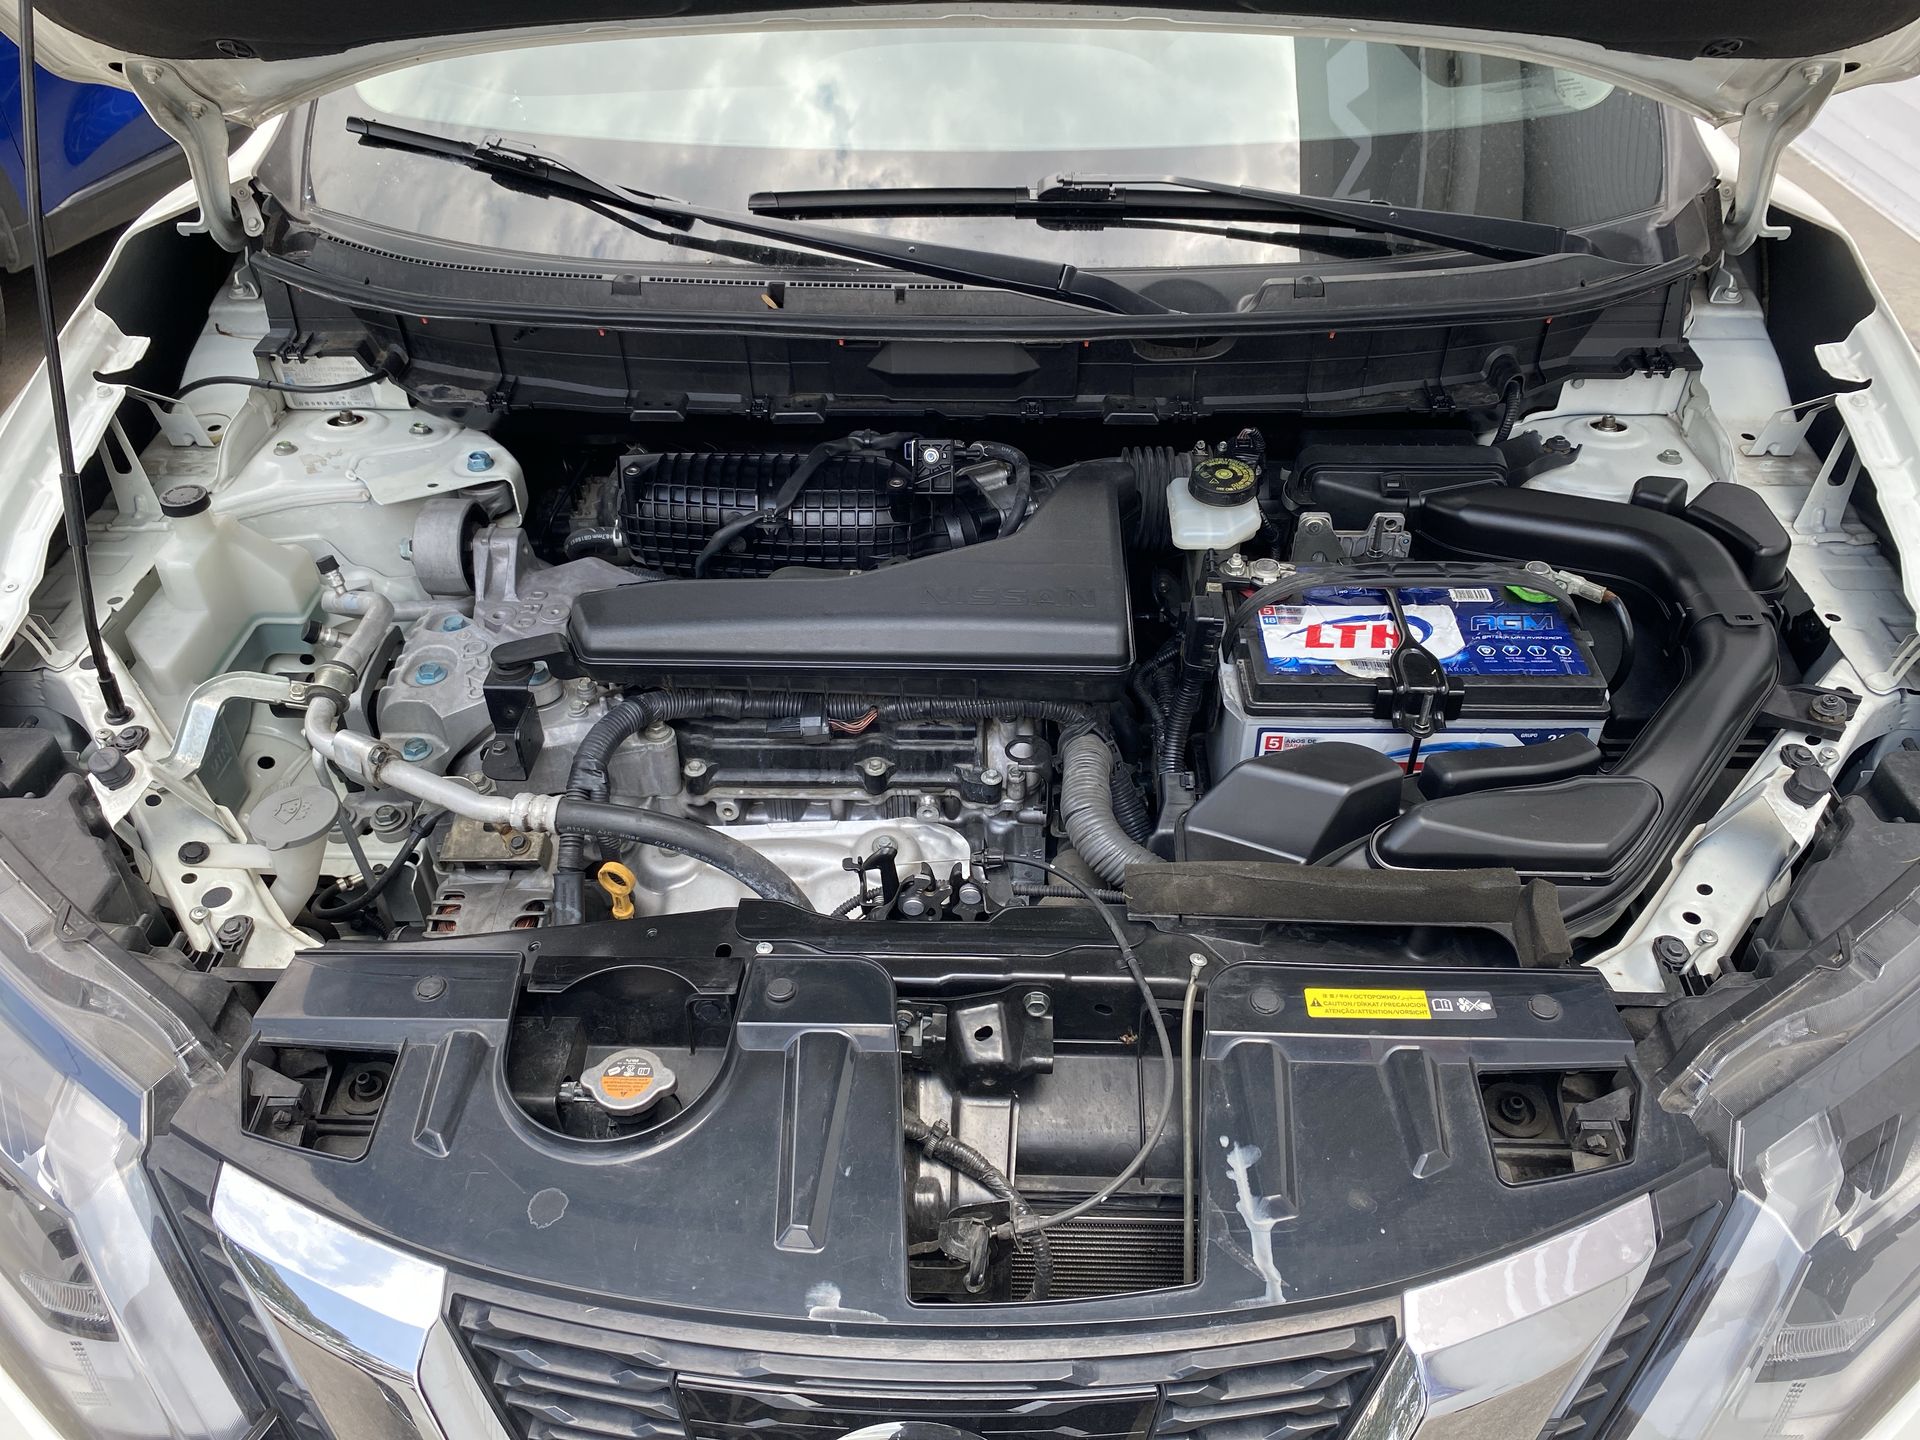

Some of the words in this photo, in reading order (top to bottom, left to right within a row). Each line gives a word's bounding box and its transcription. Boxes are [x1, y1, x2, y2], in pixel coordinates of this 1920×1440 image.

[919, 586, 1097, 607] NISSAN
[1470, 615, 1554, 631] AGM
[1304, 623, 1401, 649] LTH
[1268, 738, 1280, 748] 5
